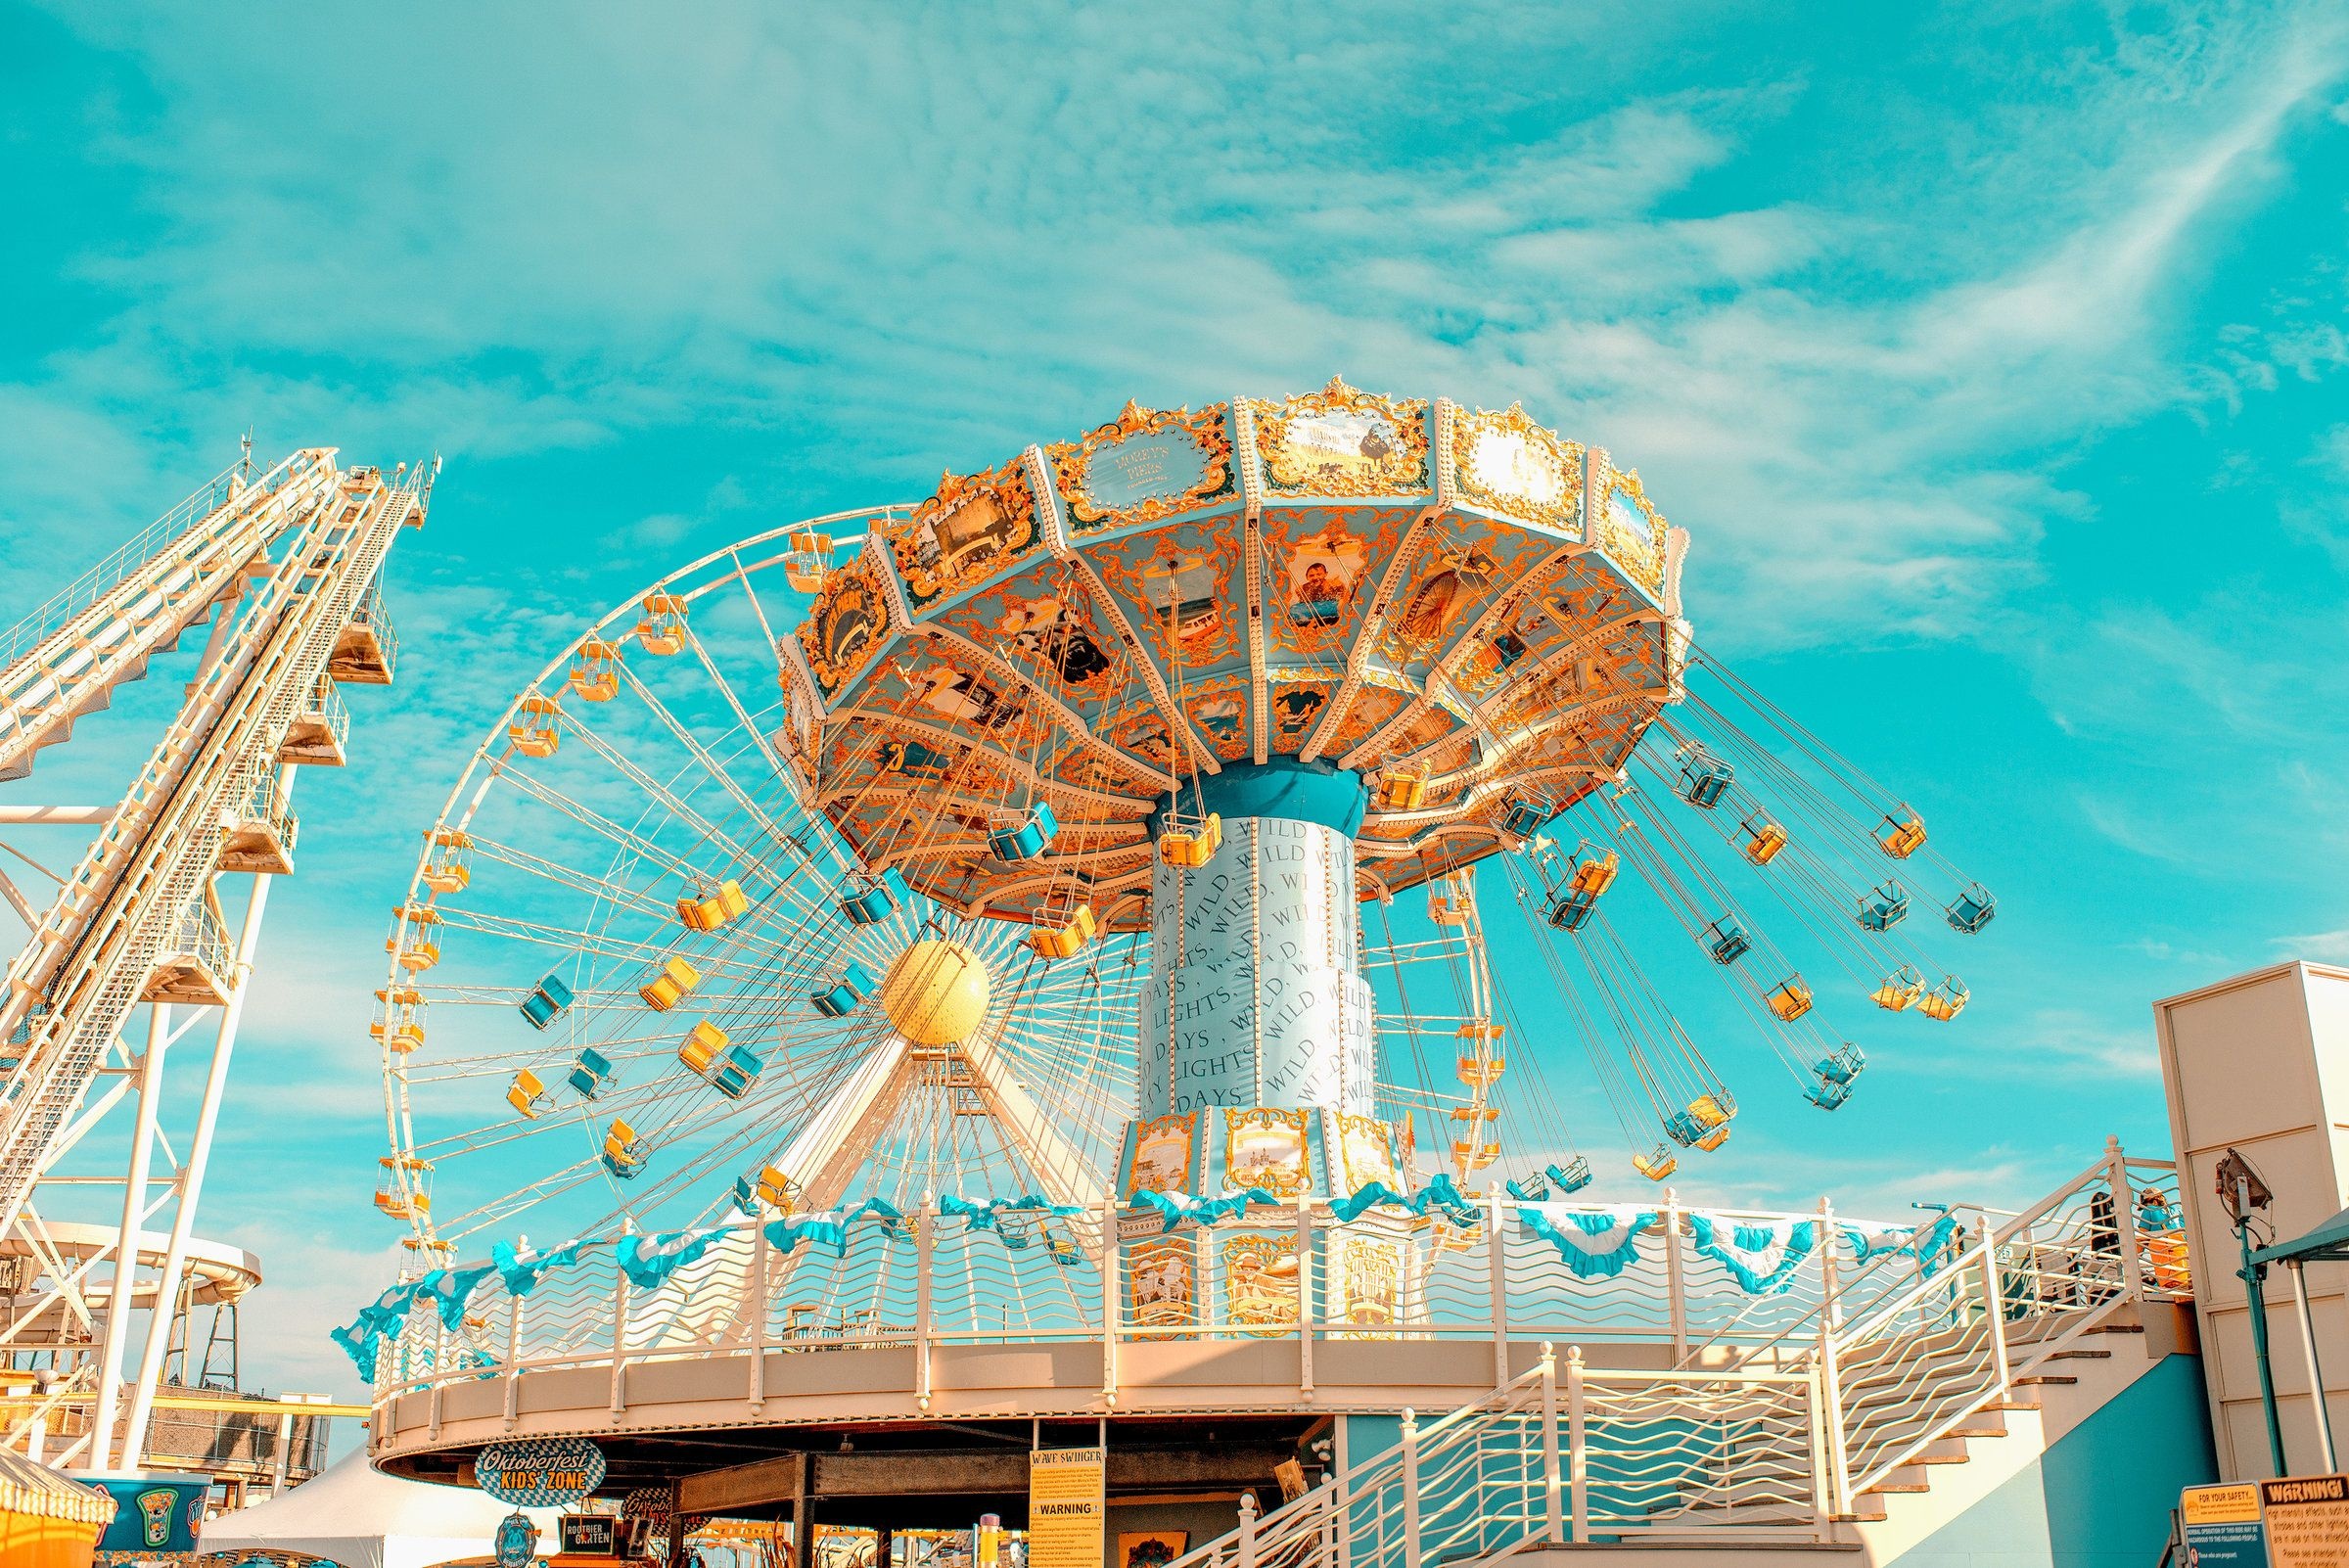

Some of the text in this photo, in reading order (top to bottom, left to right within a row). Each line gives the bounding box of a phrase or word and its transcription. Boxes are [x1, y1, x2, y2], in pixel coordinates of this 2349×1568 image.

[1127, 461, 1164, 481] PIERS
[1185, 873, 1236, 931] WILD,
[1154, 986, 1238, 1029] LIGHTS,
[1155, 1029, 1210, 1062] DAYS
[1175, 1043, 1267, 1081] IGHTS,
[1176, 1086, 1242, 1113] DAYS
[484, 1450, 589, 1473] Oktoberfest
[1032, 1451, 1102, 1464] WAVE SWINGER
[500, 1471, 587, 1490] KIDS' ZONE
[2268, 1479, 2344, 1503] WARNING!
[1040, 1503, 1091, 1515] WARNING
[2198, 1494, 2210, 1503] FOR
[2211, 1492, 2227, 1502] YOUR
